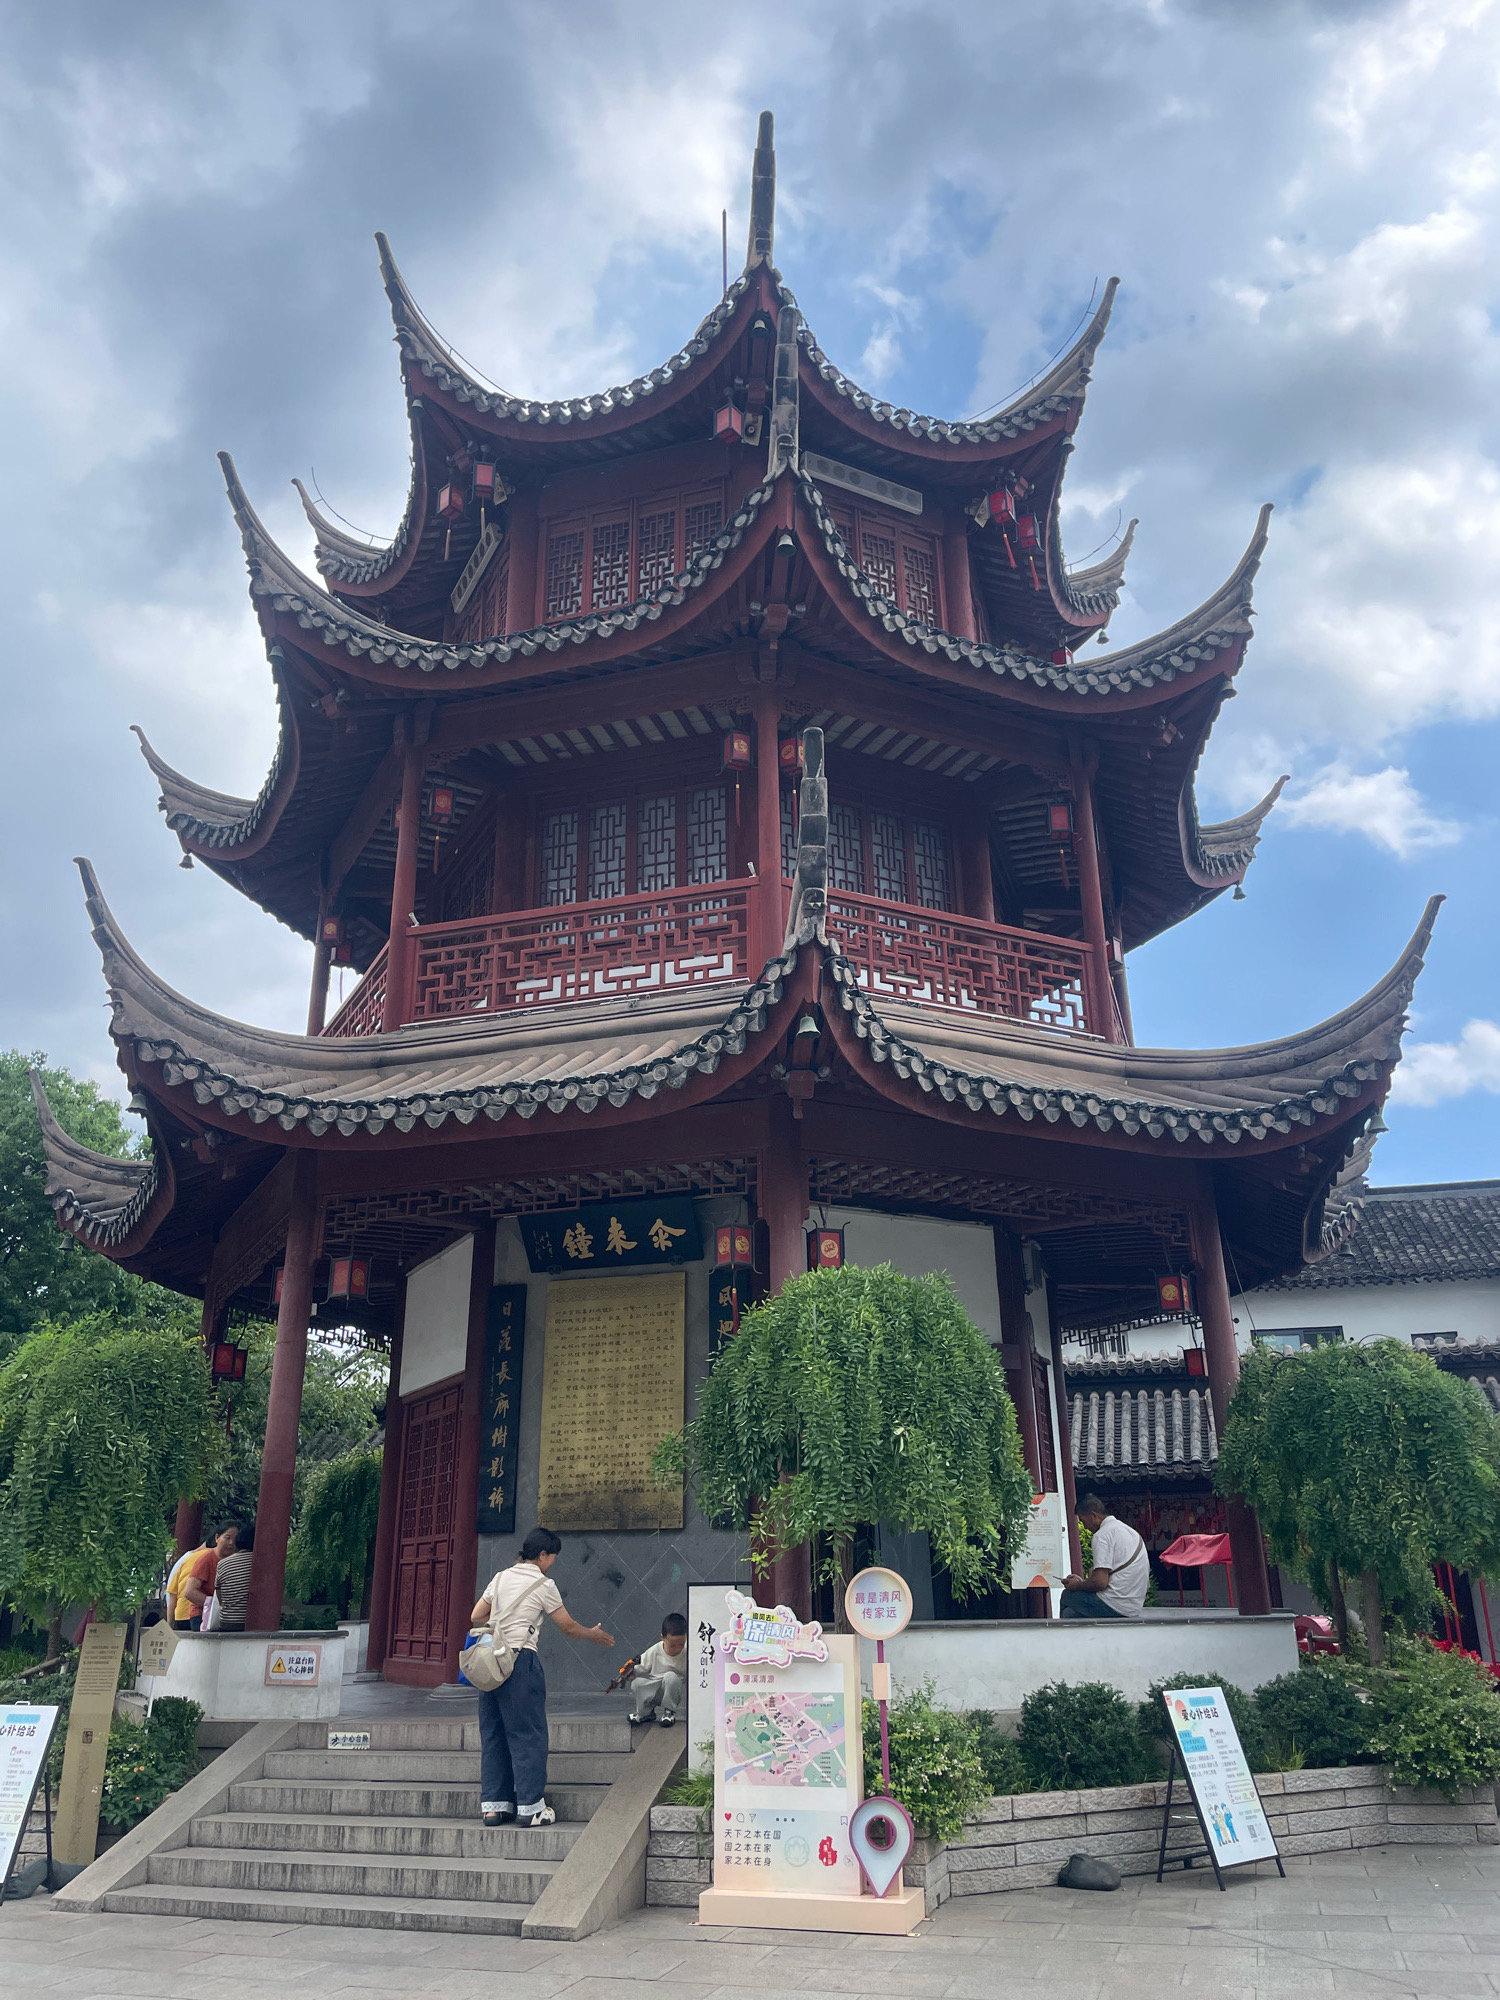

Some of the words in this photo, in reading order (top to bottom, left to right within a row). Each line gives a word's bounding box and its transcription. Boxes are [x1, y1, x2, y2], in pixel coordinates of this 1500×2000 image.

[855, 1590, 902, 1604] 最是清风
[862, 1606, 897, 1619] 传家远
[743, 1618, 797, 1643] 探清风
[288, 1656, 314, 1665] 注意台阶
[699, 1645, 709, 1689] 文创中心
[1181, 1707, 1219, 1721] 爱心补给站
[341, 1733, 369, 1743] 小心台阶
[724, 1828, 781, 1840] 天下之本在国
[724, 1841, 772, 1853] 国之本在家
[724, 1855, 772, 1866] 家之本在身
